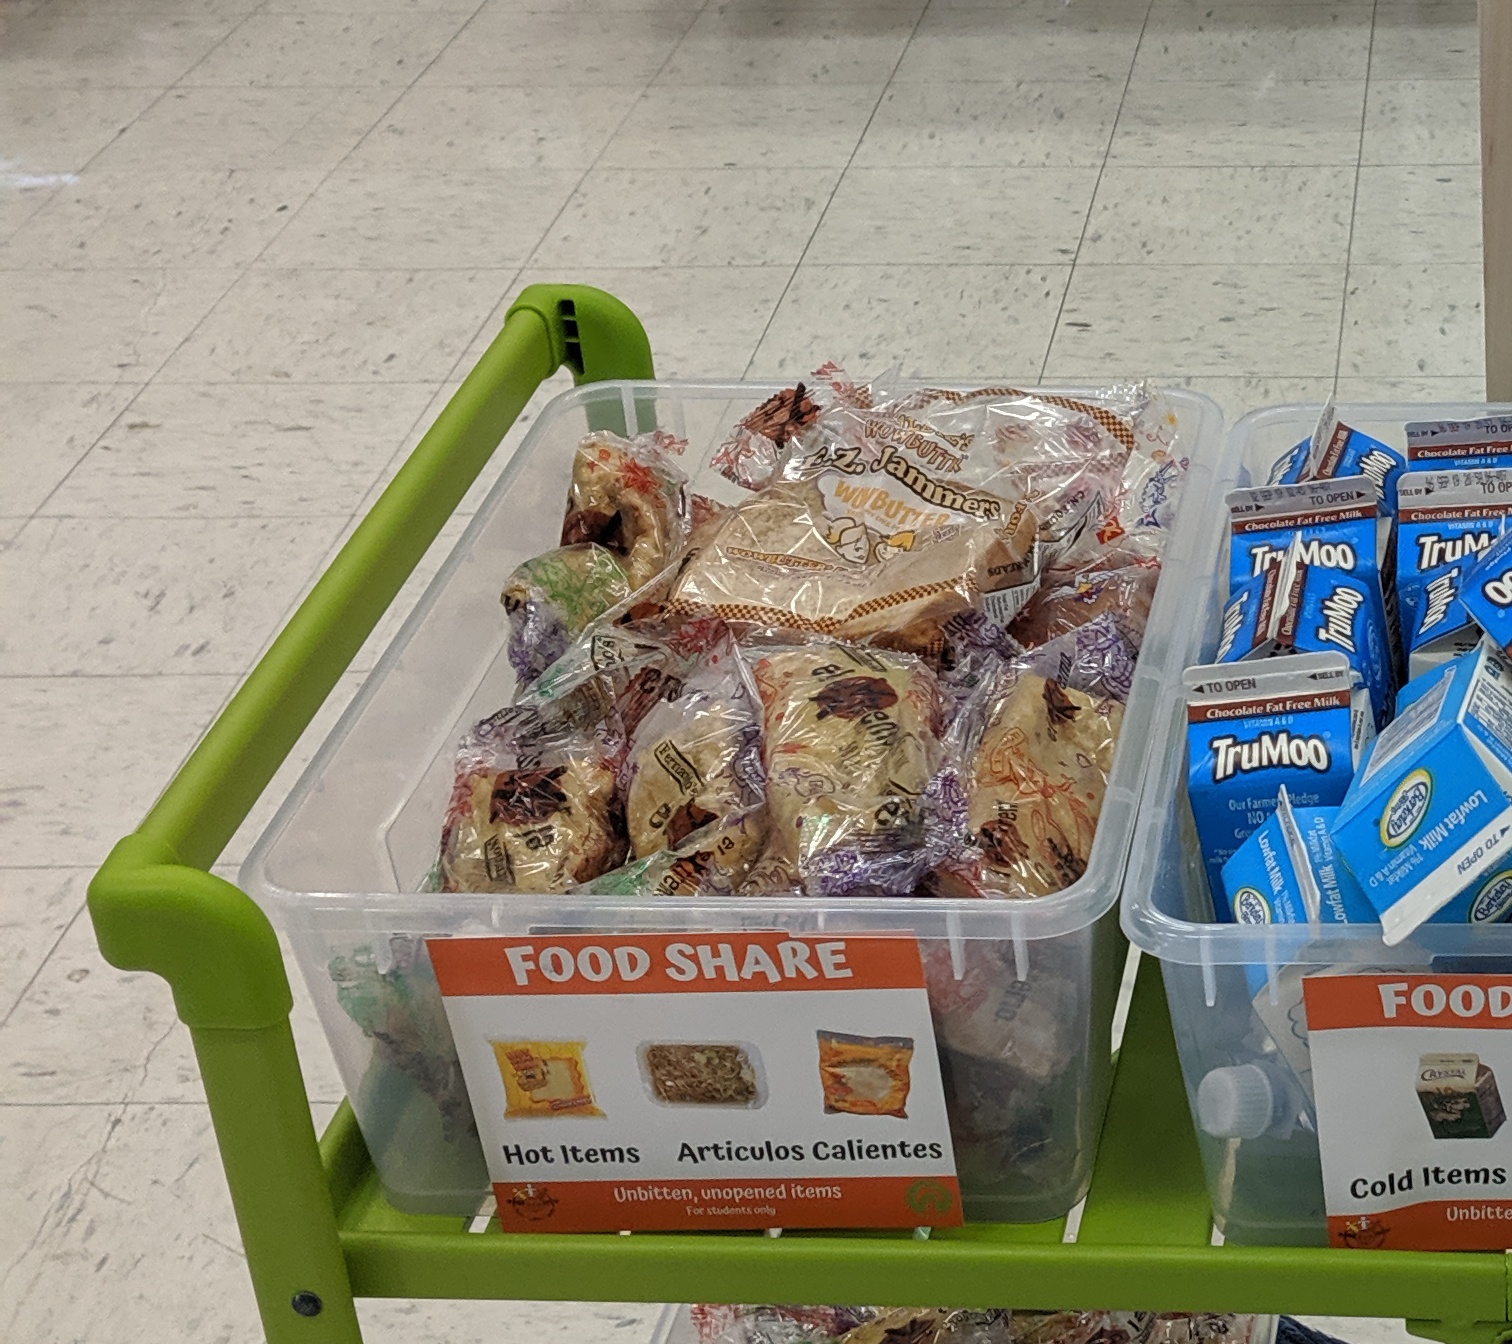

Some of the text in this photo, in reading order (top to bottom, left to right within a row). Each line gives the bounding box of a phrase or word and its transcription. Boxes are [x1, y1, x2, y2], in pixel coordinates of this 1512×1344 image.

[1485, 424, 1498, 434] TO
[1417, 448, 1467, 458] Chocolate
[1469, 446, 1485, 455] Fat
[1486, 445, 1510, 454] Free
[869, 444, 1001, 522] Jammers
[1481, 483, 1495, 494] TO
[1309, 492, 1354, 506] TO OPEN
[1244, 510, 1363, 532] Chocolate Free Milk
[1410, 506, 1505, 521] Chocolate Fat Free
[1418, 532, 1497, 571] TruM
[1318, 587, 1364, 653] TruMoo
[1207, 678, 1257, 694] TO OPEN
[1206, 696, 1341, 719] Chocolate Fat Free Milk
[1212, 732, 1329, 781] TruMoo
[1418, 789, 1489, 851] Lowfat Milk
[1485, 835, 1501, 851] TO
[1456, 847, 1484, 876] OPEN
[504, 940, 854, 987] FOOD SHARE
[503, 1142, 641, 1166] Hot Items
[677, 1138, 943, 1164] Articulos Calientes
[614, 1182, 843, 1204] Unbitten, unopened items
[1349, 1163, 1508, 1200] Cold Items
